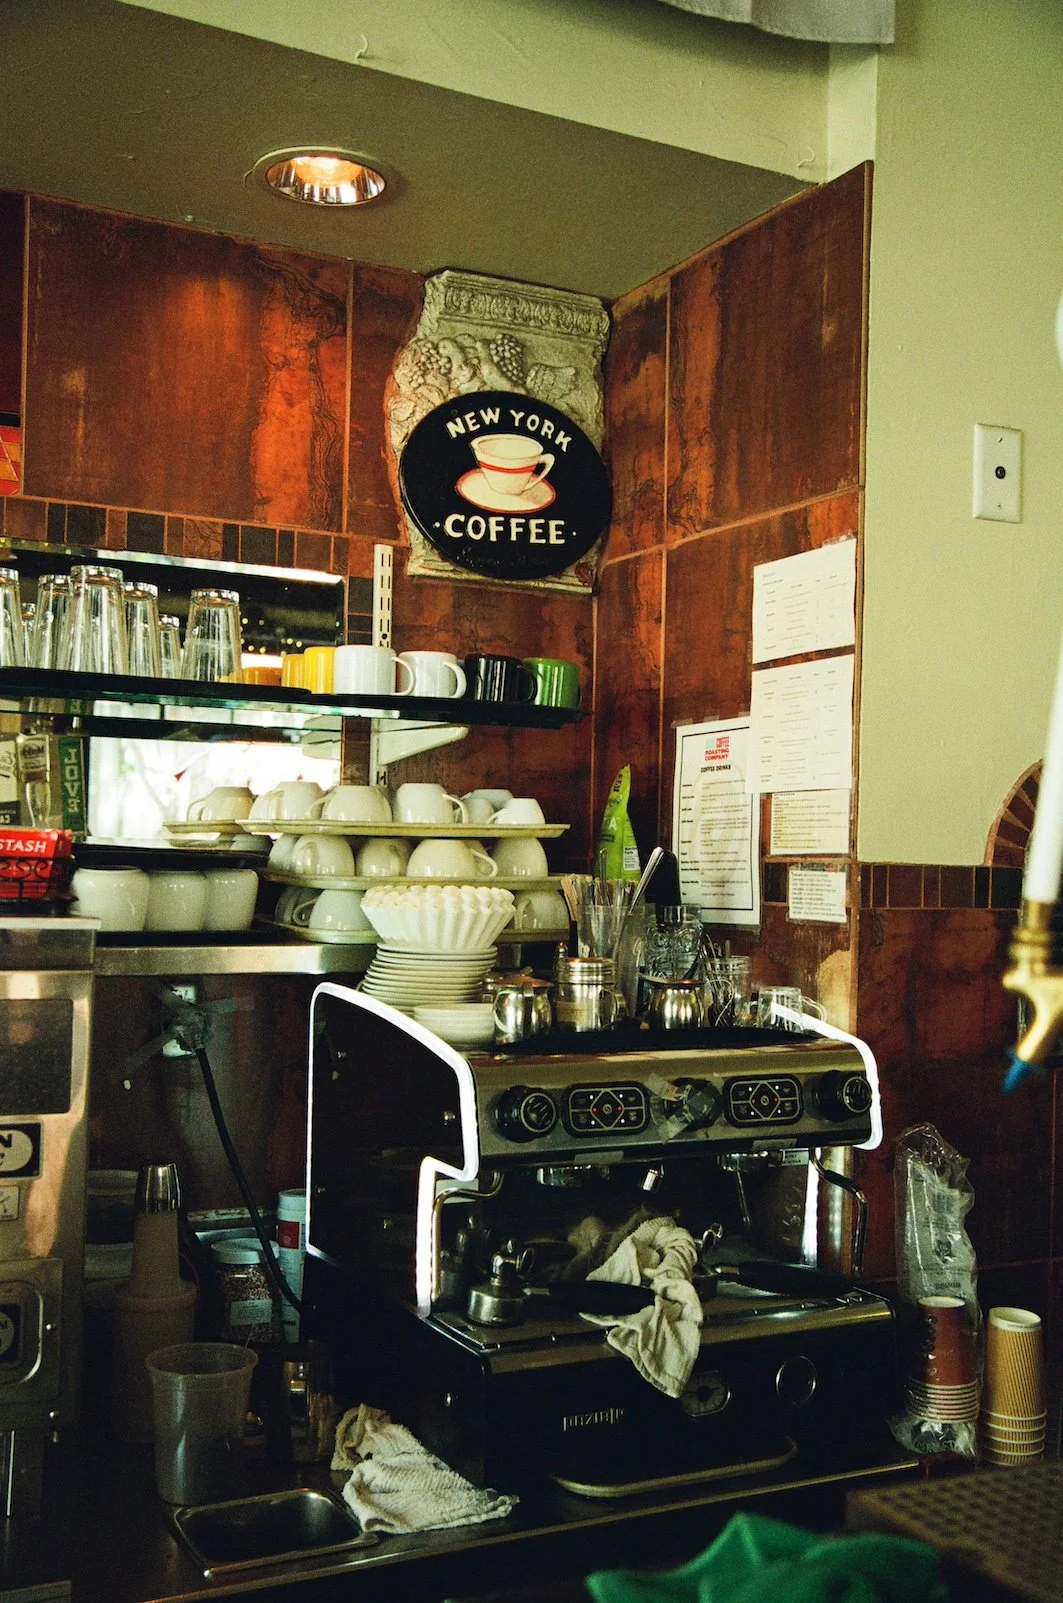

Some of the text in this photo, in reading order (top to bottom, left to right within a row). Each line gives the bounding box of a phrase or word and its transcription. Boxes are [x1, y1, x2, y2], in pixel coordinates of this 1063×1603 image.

[446, 407, 572, 453] NEW YORK
[444, 513, 566, 545] COFFEE
[0, 838, 47, 853] STASH
